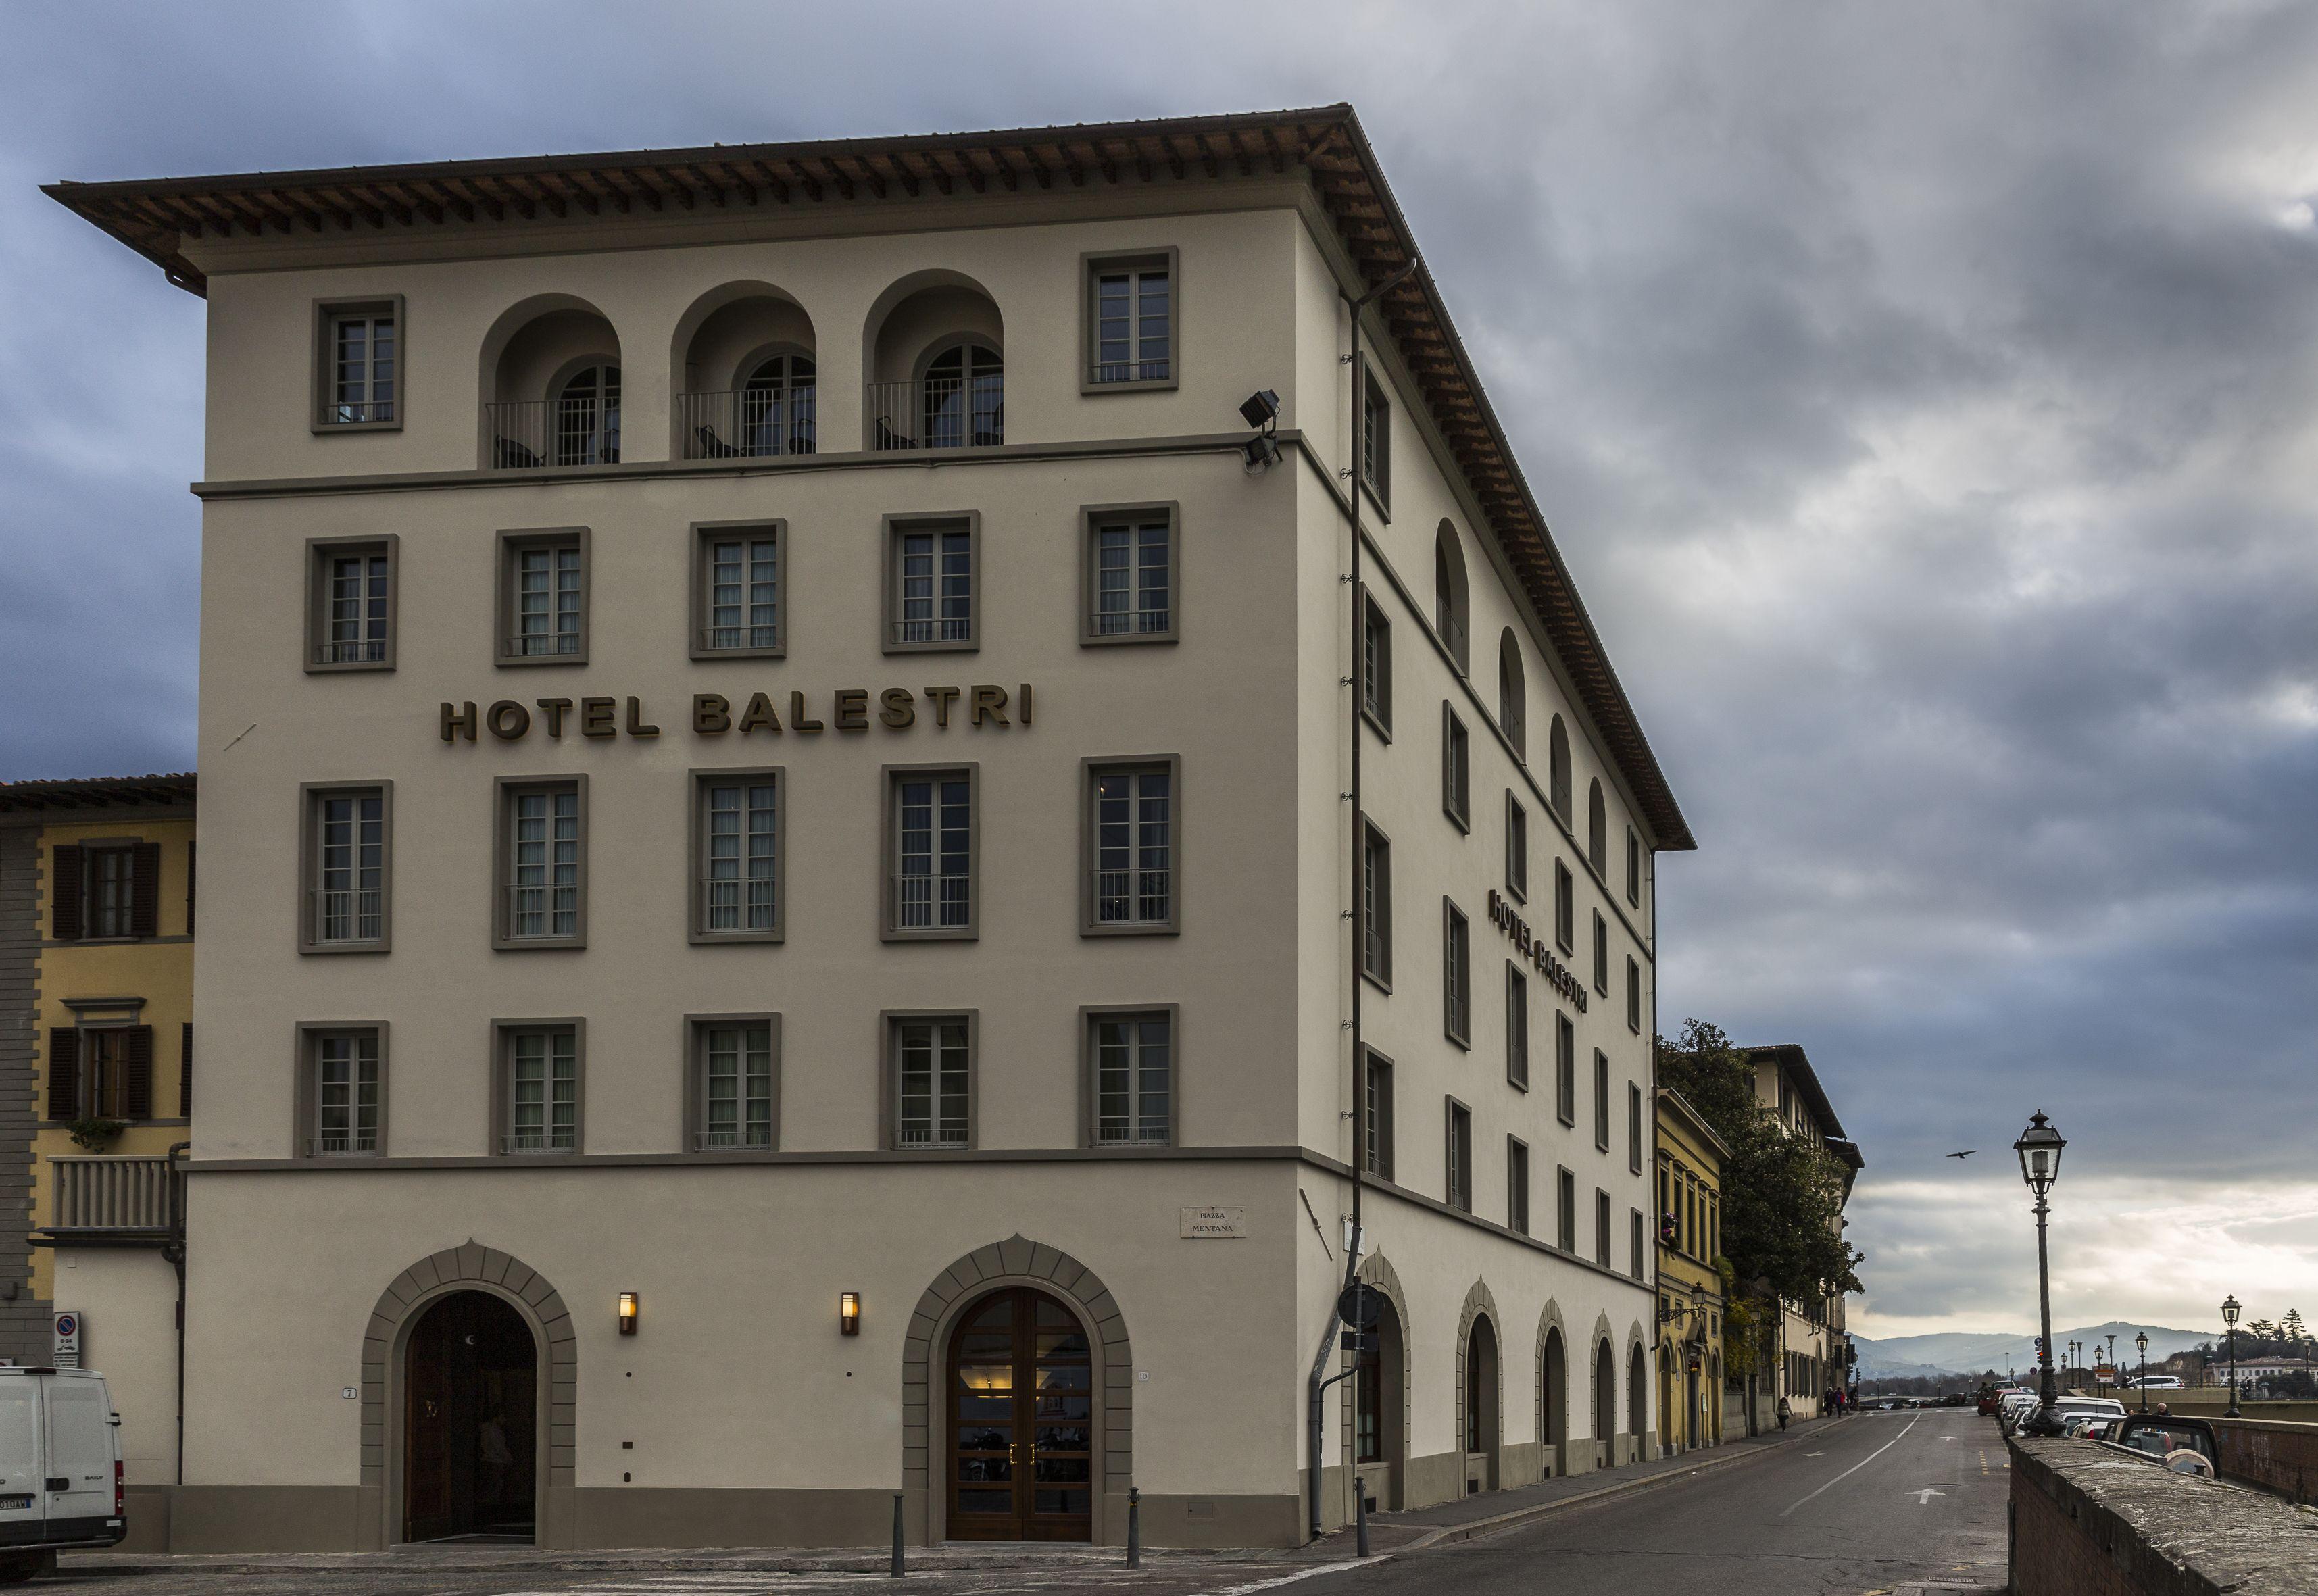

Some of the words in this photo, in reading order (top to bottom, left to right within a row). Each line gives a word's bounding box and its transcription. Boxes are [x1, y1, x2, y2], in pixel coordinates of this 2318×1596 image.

[440, 695, 660, 742] HOTEL
[692, 683, 1033, 735] BALESTRI
[1489, 889, 1534, 957] HOTEL
[1534, 939, 1587, 1013] BALESTRI
